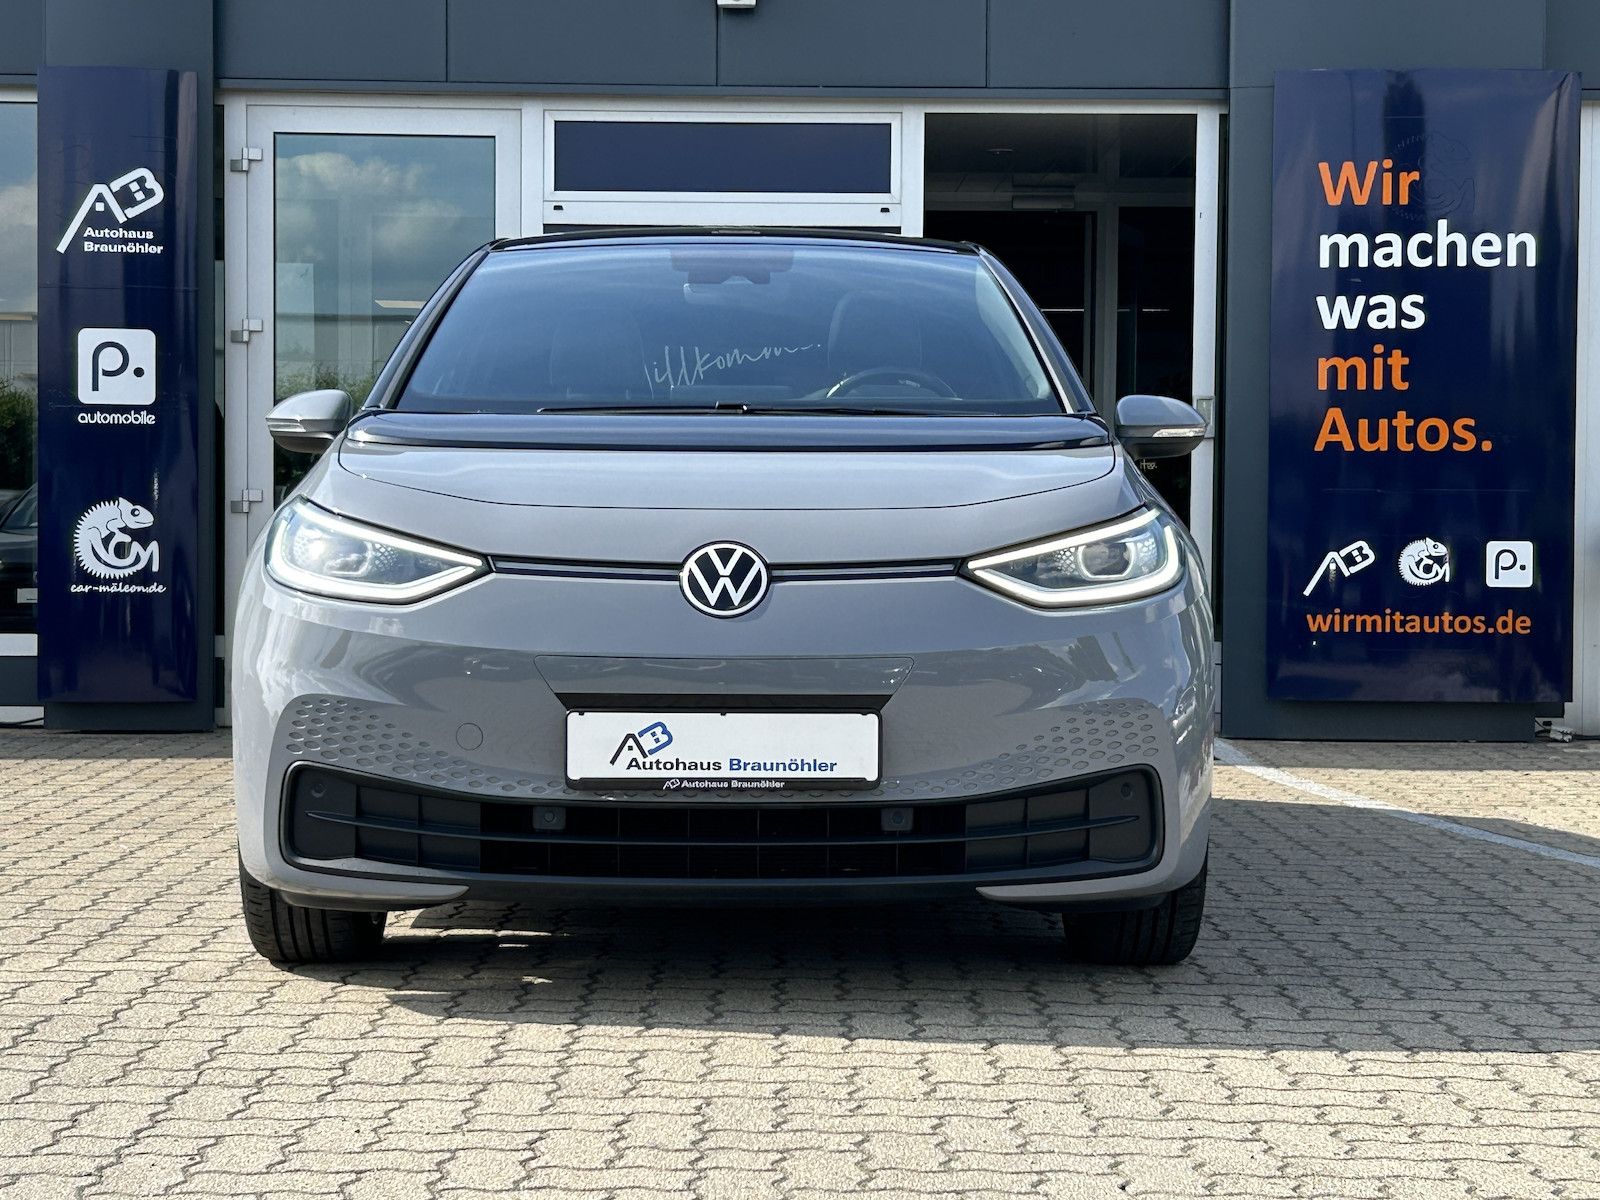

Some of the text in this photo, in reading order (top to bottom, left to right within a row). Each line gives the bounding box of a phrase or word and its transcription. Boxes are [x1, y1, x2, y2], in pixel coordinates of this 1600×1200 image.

[1317, 158, 1420, 206] Wir
[83, 226, 154, 240] Autohaus
[1318, 218, 1537, 268] machen
[83, 240, 164, 255] Braunöhler
[1315, 293, 1426, 330] was
[1317, 343, 1410, 391] mit
[77, 410, 156, 425] automobile
[1313, 406, 1494, 452] Autos.
[70, 582, 167, 593] car-mäleon.de
[1306, 608, 1533, 635] wirmitautos.de
[625, 756, 838, 773] Autohaus Braunöhler
[681, 779, 729, 789] Autohaus
[731, 778, 786, 789] Braunöhler
